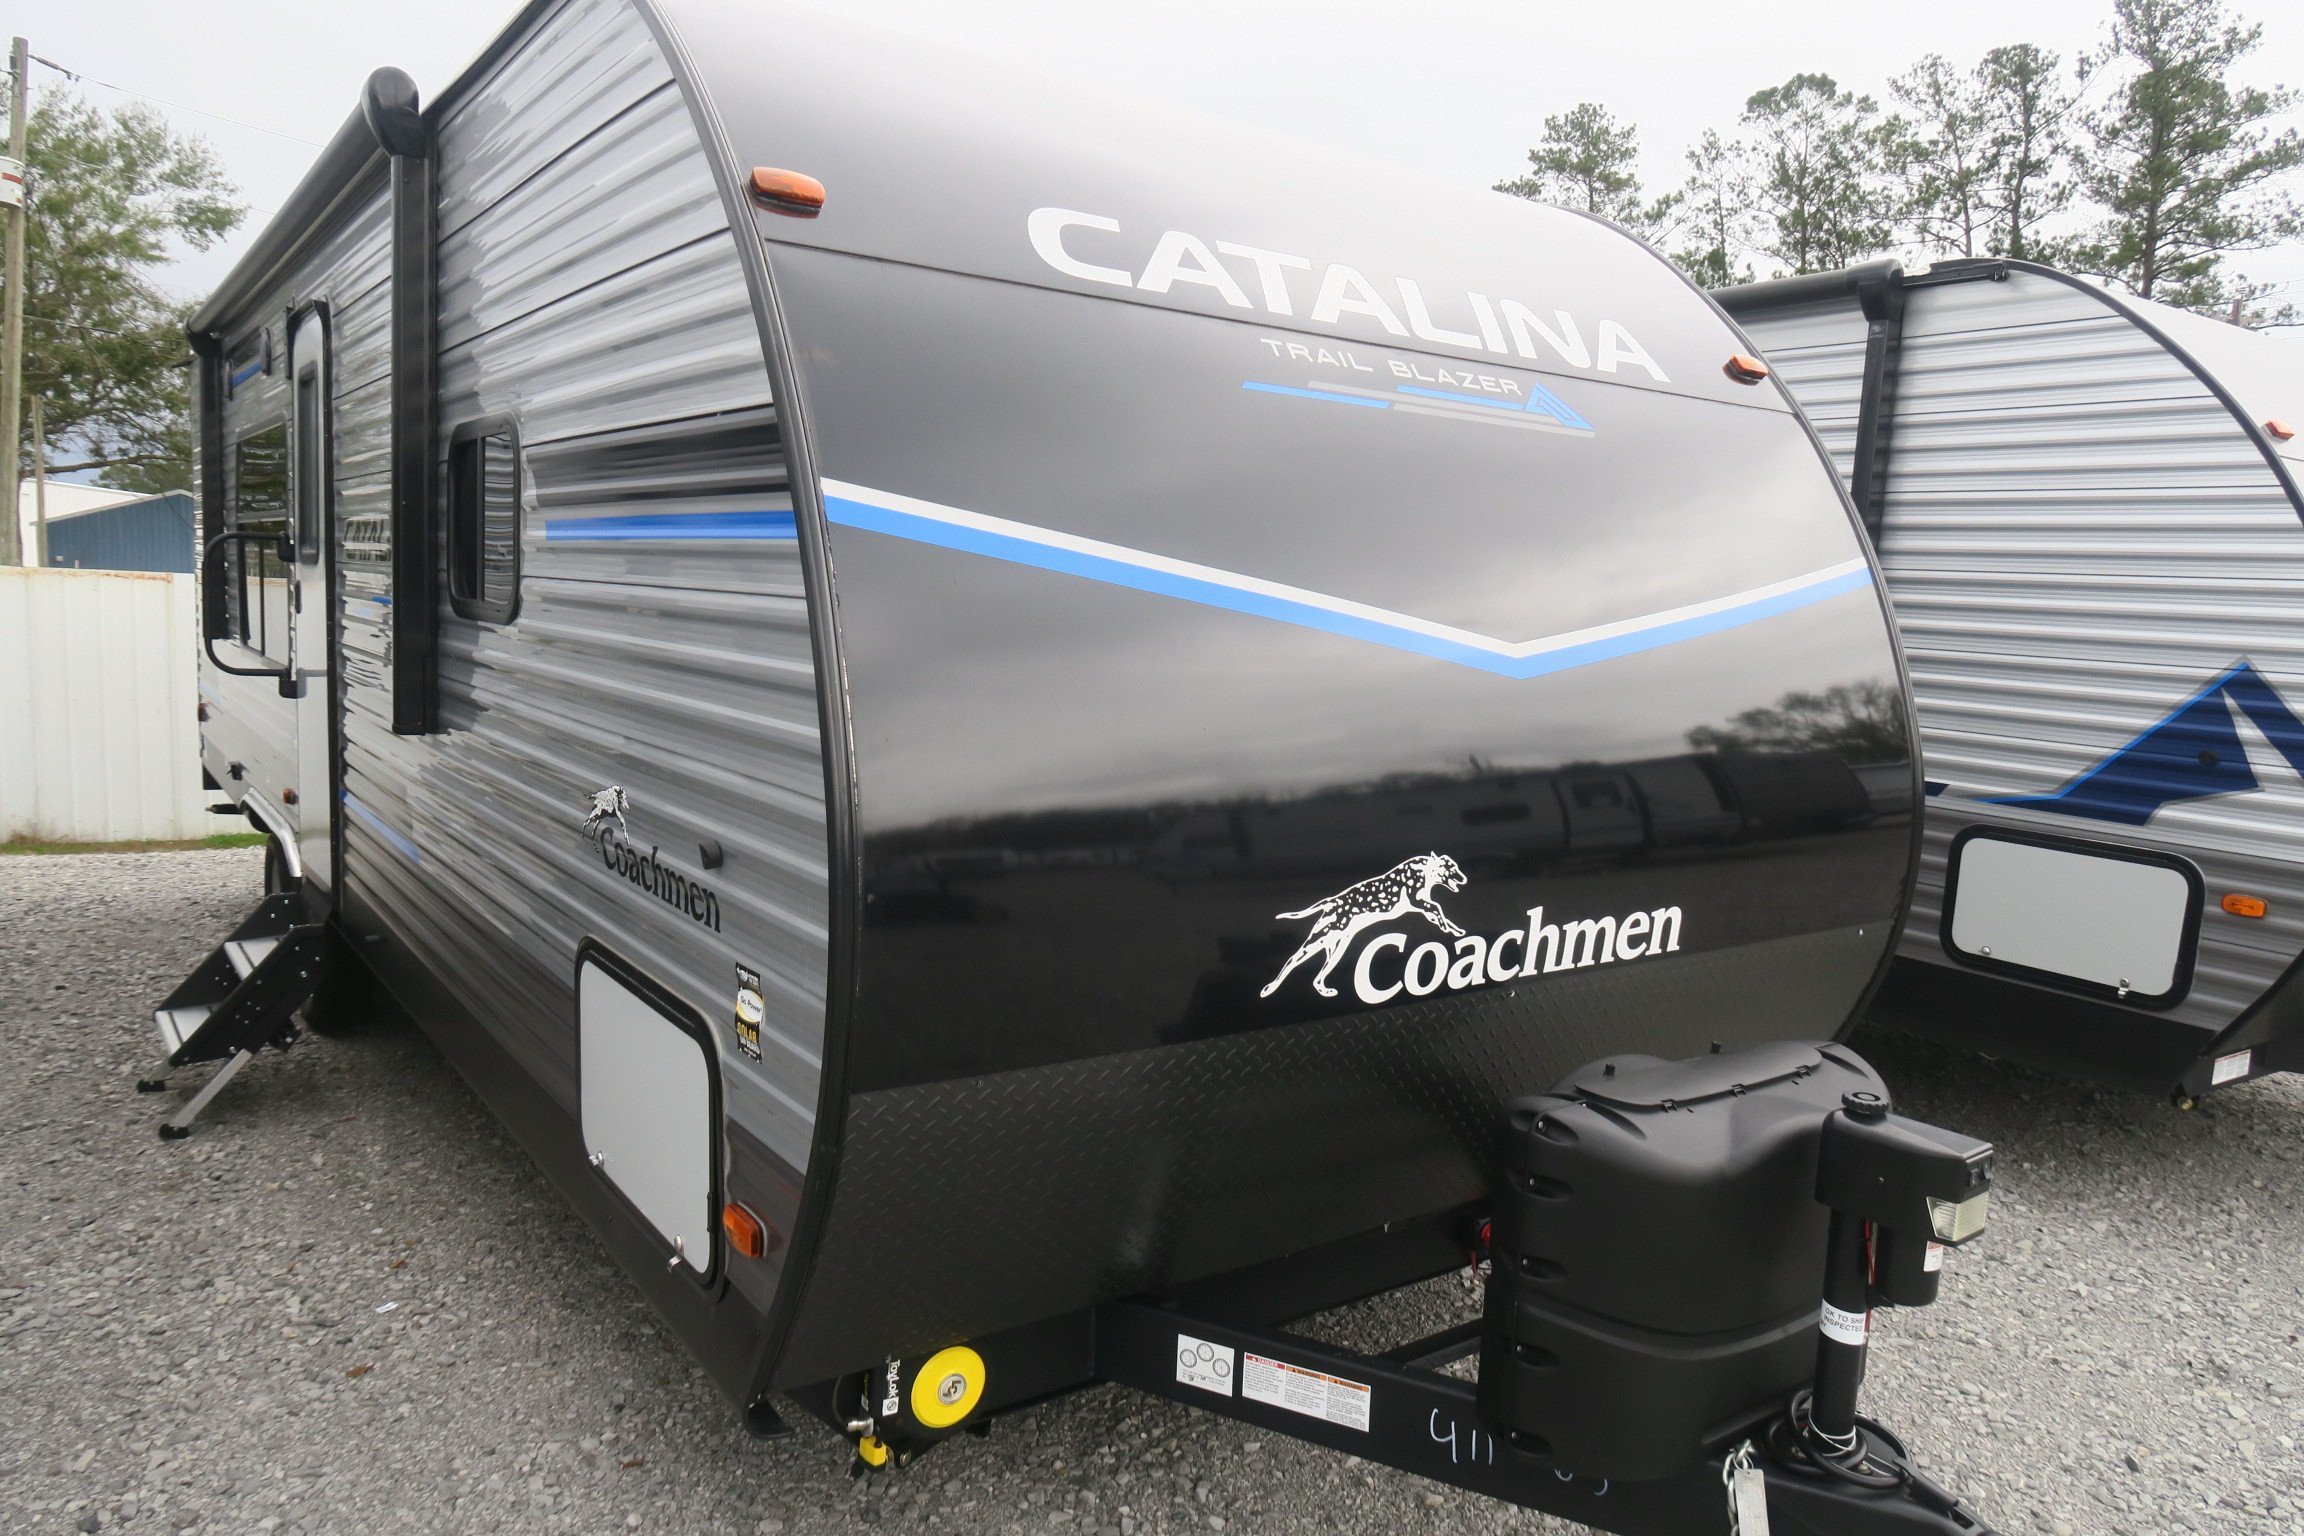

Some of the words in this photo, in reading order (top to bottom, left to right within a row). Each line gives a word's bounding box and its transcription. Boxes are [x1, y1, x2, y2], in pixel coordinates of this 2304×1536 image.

[1028, 207, 1671, 384] CATALINA
[1260, 338, 1374, 373] TRAIL
[1388, 359, 1523, 397] BLAZER
[600, 826, 722, 933] Coachmen
[1353, 905, 1682, 1005] Coachmen
[736, 1021, 758, 1045] SOLAR
[1823, 1314, 1863, 1332] INSPECTED
[1825, 1307, 1835, 1318] OK
[1837, 1314, 1849, 1323] TO
[886, 1359, 901, 1399] ToyLok
[1257, 1358, 1279, 1368] DANGER
